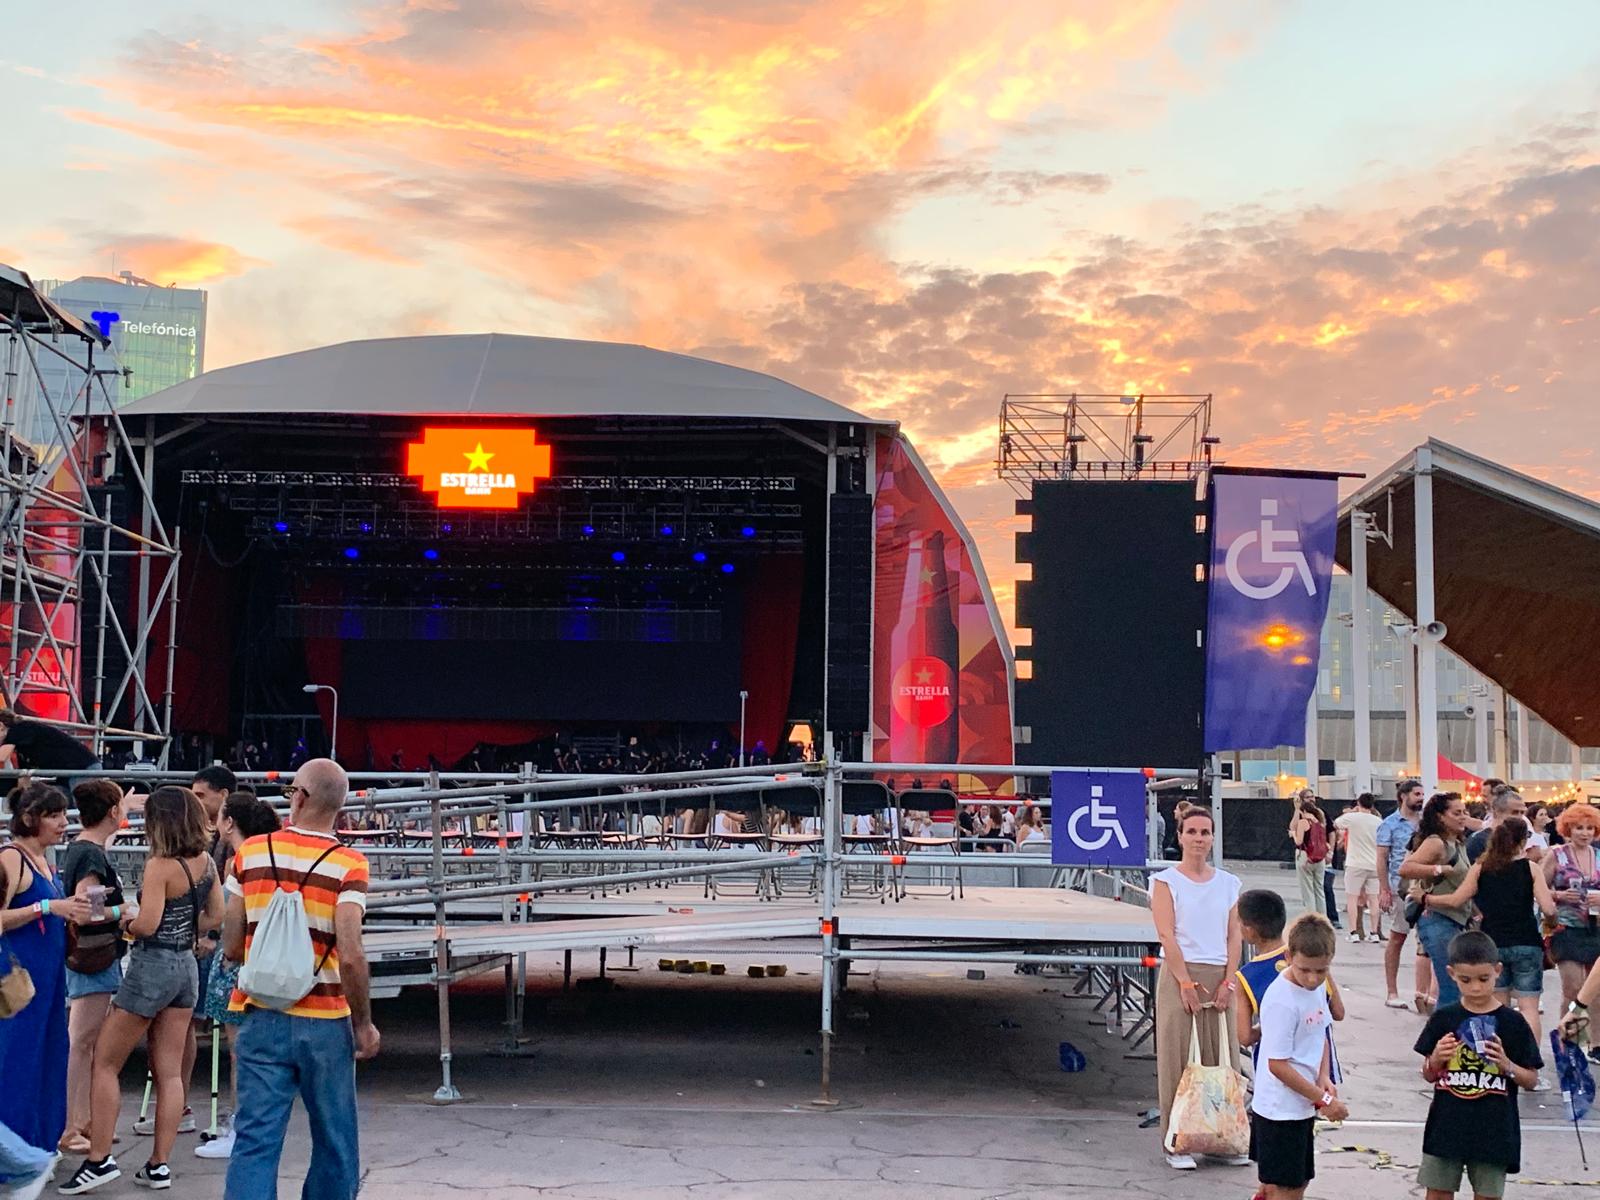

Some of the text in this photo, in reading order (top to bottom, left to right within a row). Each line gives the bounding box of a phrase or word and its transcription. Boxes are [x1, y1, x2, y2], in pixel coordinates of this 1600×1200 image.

[122, 320, 196, 337] Telefónica
[440, 473, 516, 488] ESTRELLA
[899, 686, 949, 696] ESTRELLA
[1479, 1072, 1506, 1090] KAI
